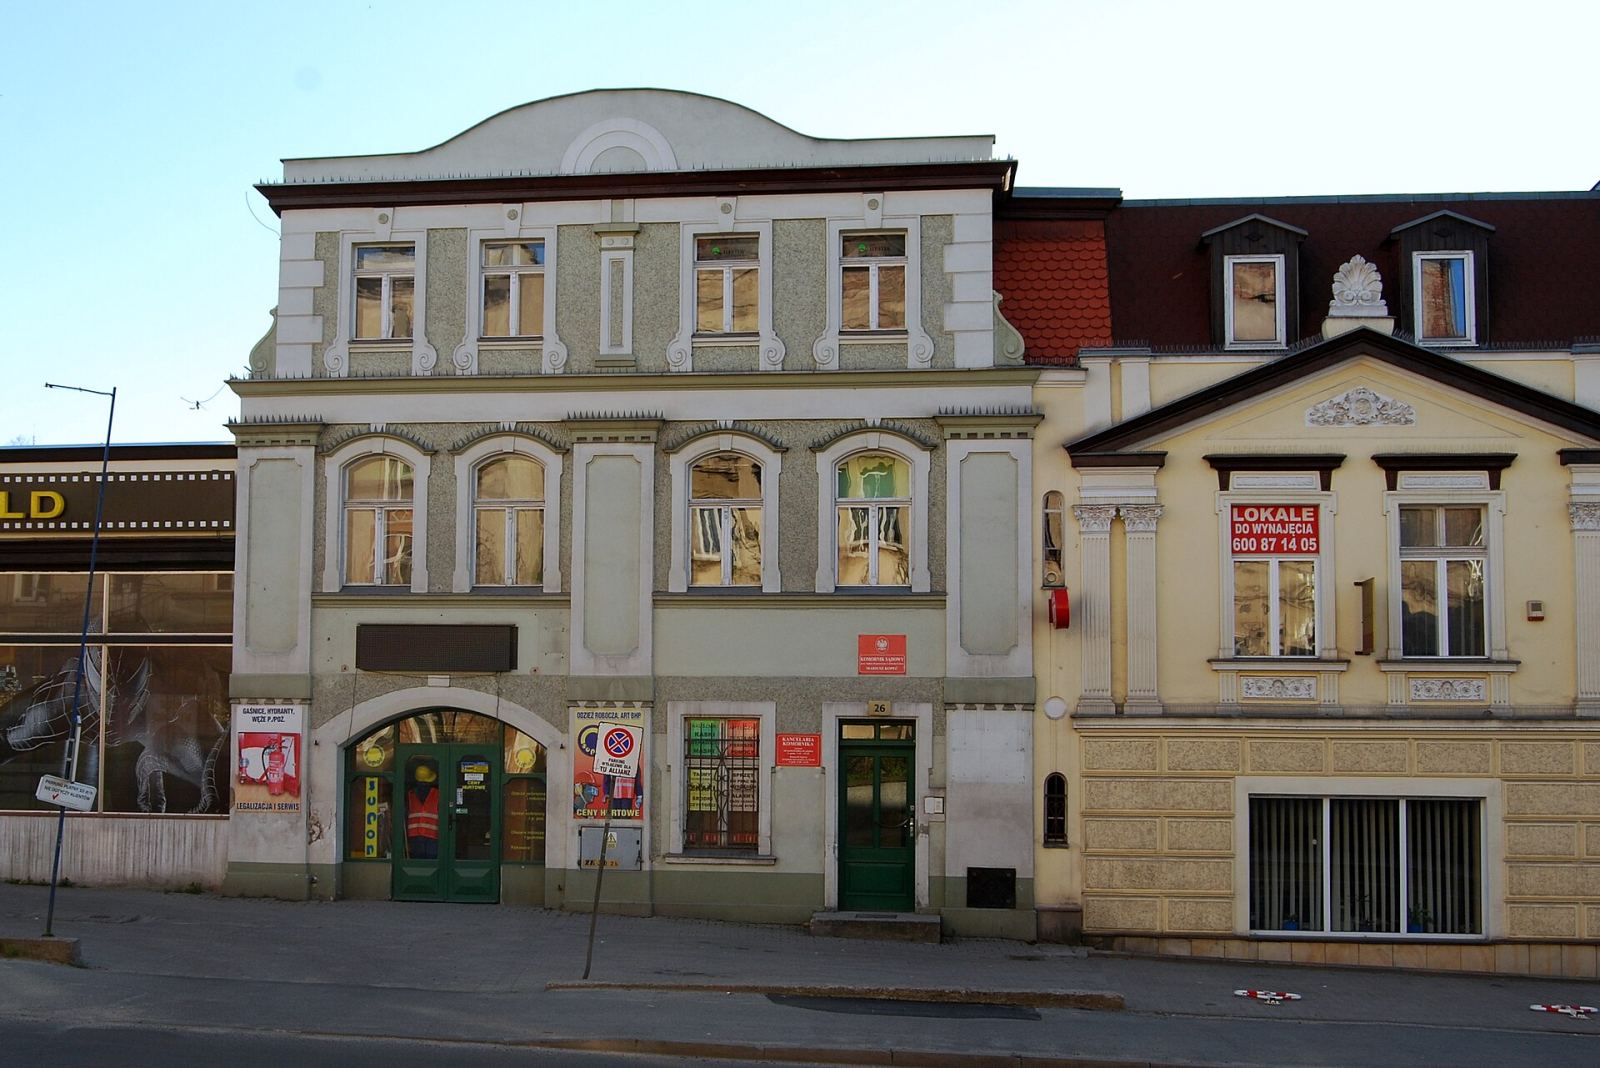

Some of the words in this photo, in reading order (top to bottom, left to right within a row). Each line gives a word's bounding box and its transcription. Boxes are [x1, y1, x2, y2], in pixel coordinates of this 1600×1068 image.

[1232, 507, 1315, 522] LOKALE
[1235, 523, 1250, 534] DO
[1252, 523, 1313, 536] WYNAJĘCIA
[1232, 537, 1257, 551] 600
[1260, 537, 1277, 551] 87
[1281, 537, 1297, 551] 14
[1300, 537, 1317, 551] 05
[874, 704, 886, 713] 26
[609, 767, 631, 776] ALLIANZ
[236, 802, 273, 810] LEGALIZACJA
[277, 802, 300, 811] SERWIS
[600, 809, 640, 817] HRTOWE
